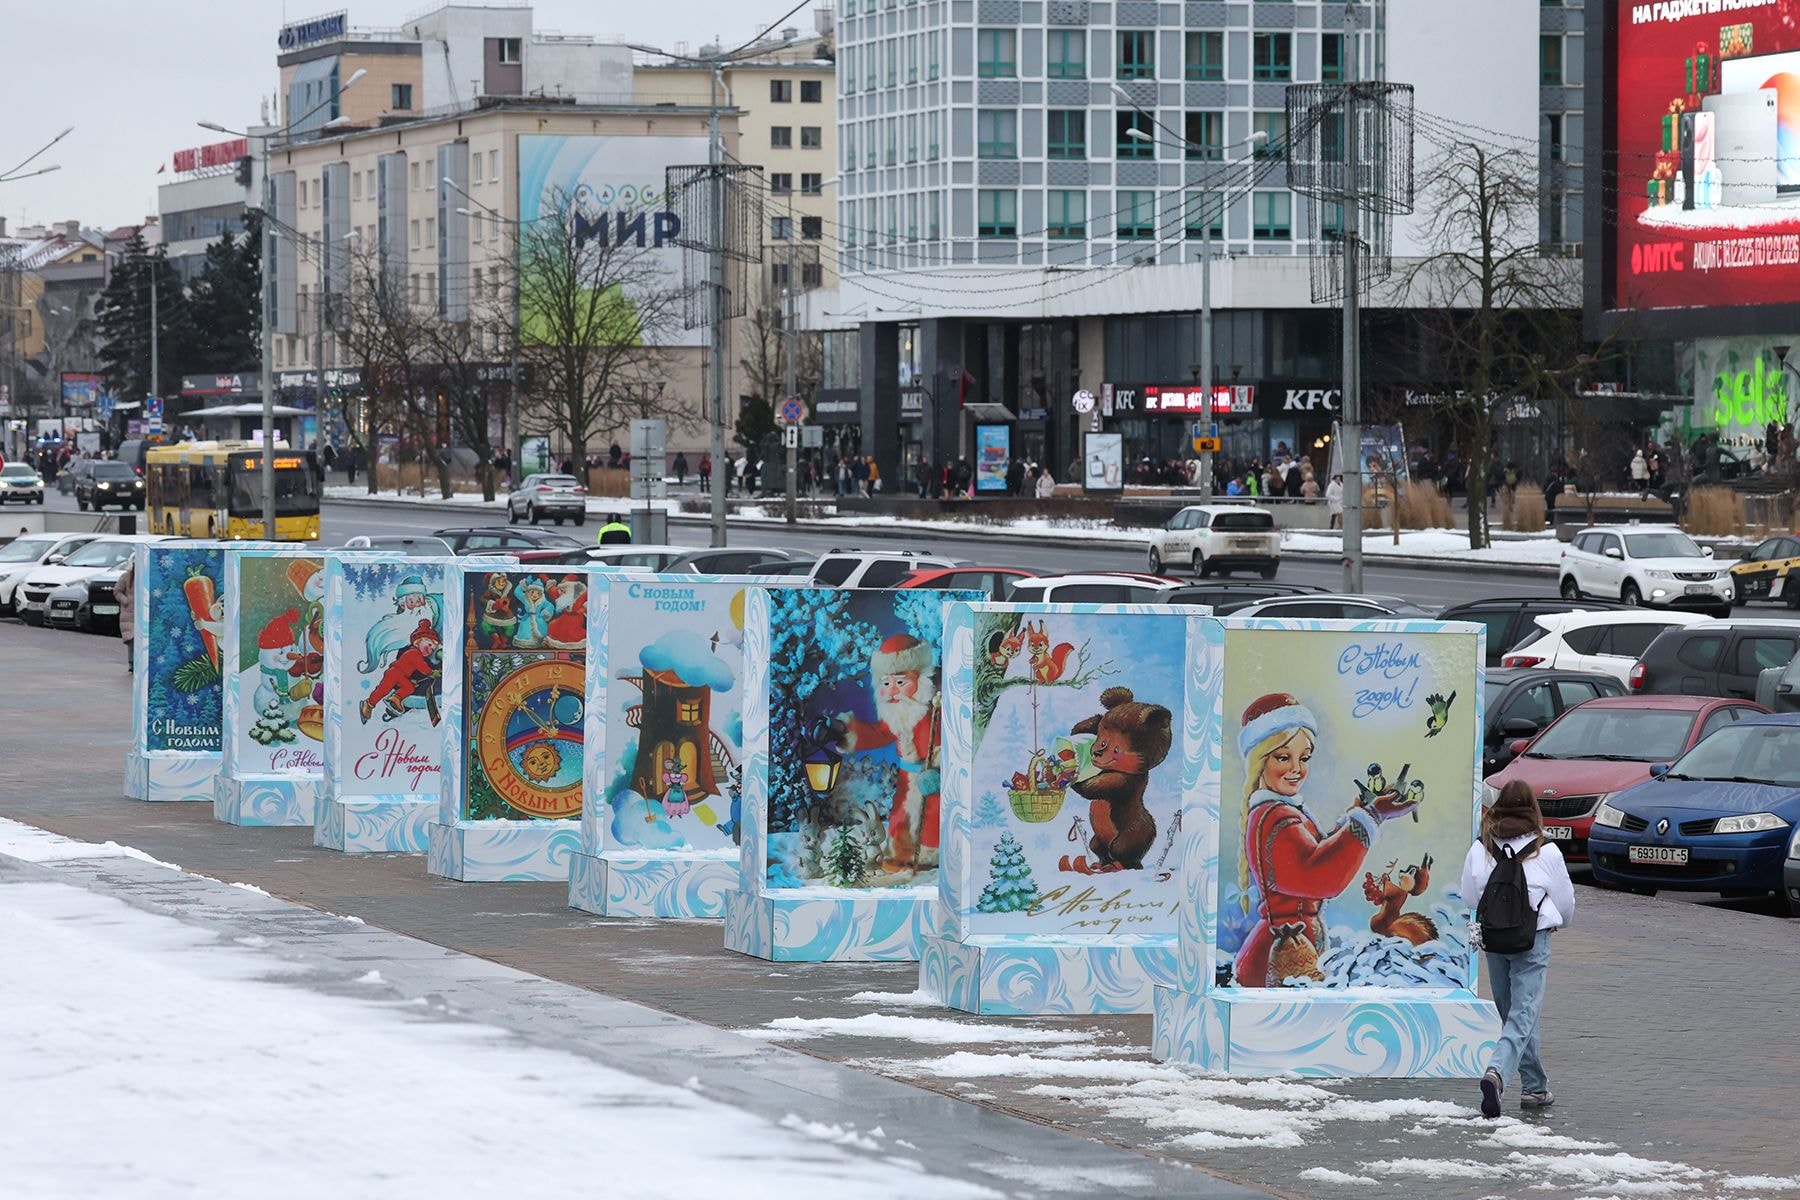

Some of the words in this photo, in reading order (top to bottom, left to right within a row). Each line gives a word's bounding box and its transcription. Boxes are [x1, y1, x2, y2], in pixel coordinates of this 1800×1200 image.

[1632, 4, 1651, 25] НА
[1653, 0, 1720, 23] ГАДЖЕТЫ
[1722, 0, 1776, 12] HON
[575, 210, 681, 248] МИР
[1643, 242, 1684, 273] МТС
[1115, 390, 1135, 410] KFC
[1282, 389, 1341, 410] KFC
[1714, 355, 1788, 428] sela
[629, 583, 641, 599] С
[1338, 644, 1361, 674] С
[1356, 642, 1421, 679] Новым
[1352, 677, 1419, 718] годом!
[152, 718, 162, 735] С
[165, 719, 220, 736] Новым
[167, 738, 221, 748] годом!
[354, 751, 379, 780] С
[375, 727, 431, 778] Новым
[270, 748, 288, 770] С
[286, 749, 324, 770] Новы
[406, 763, 441, 792] годом
[1546, 827, 1571, 839] OT-7
